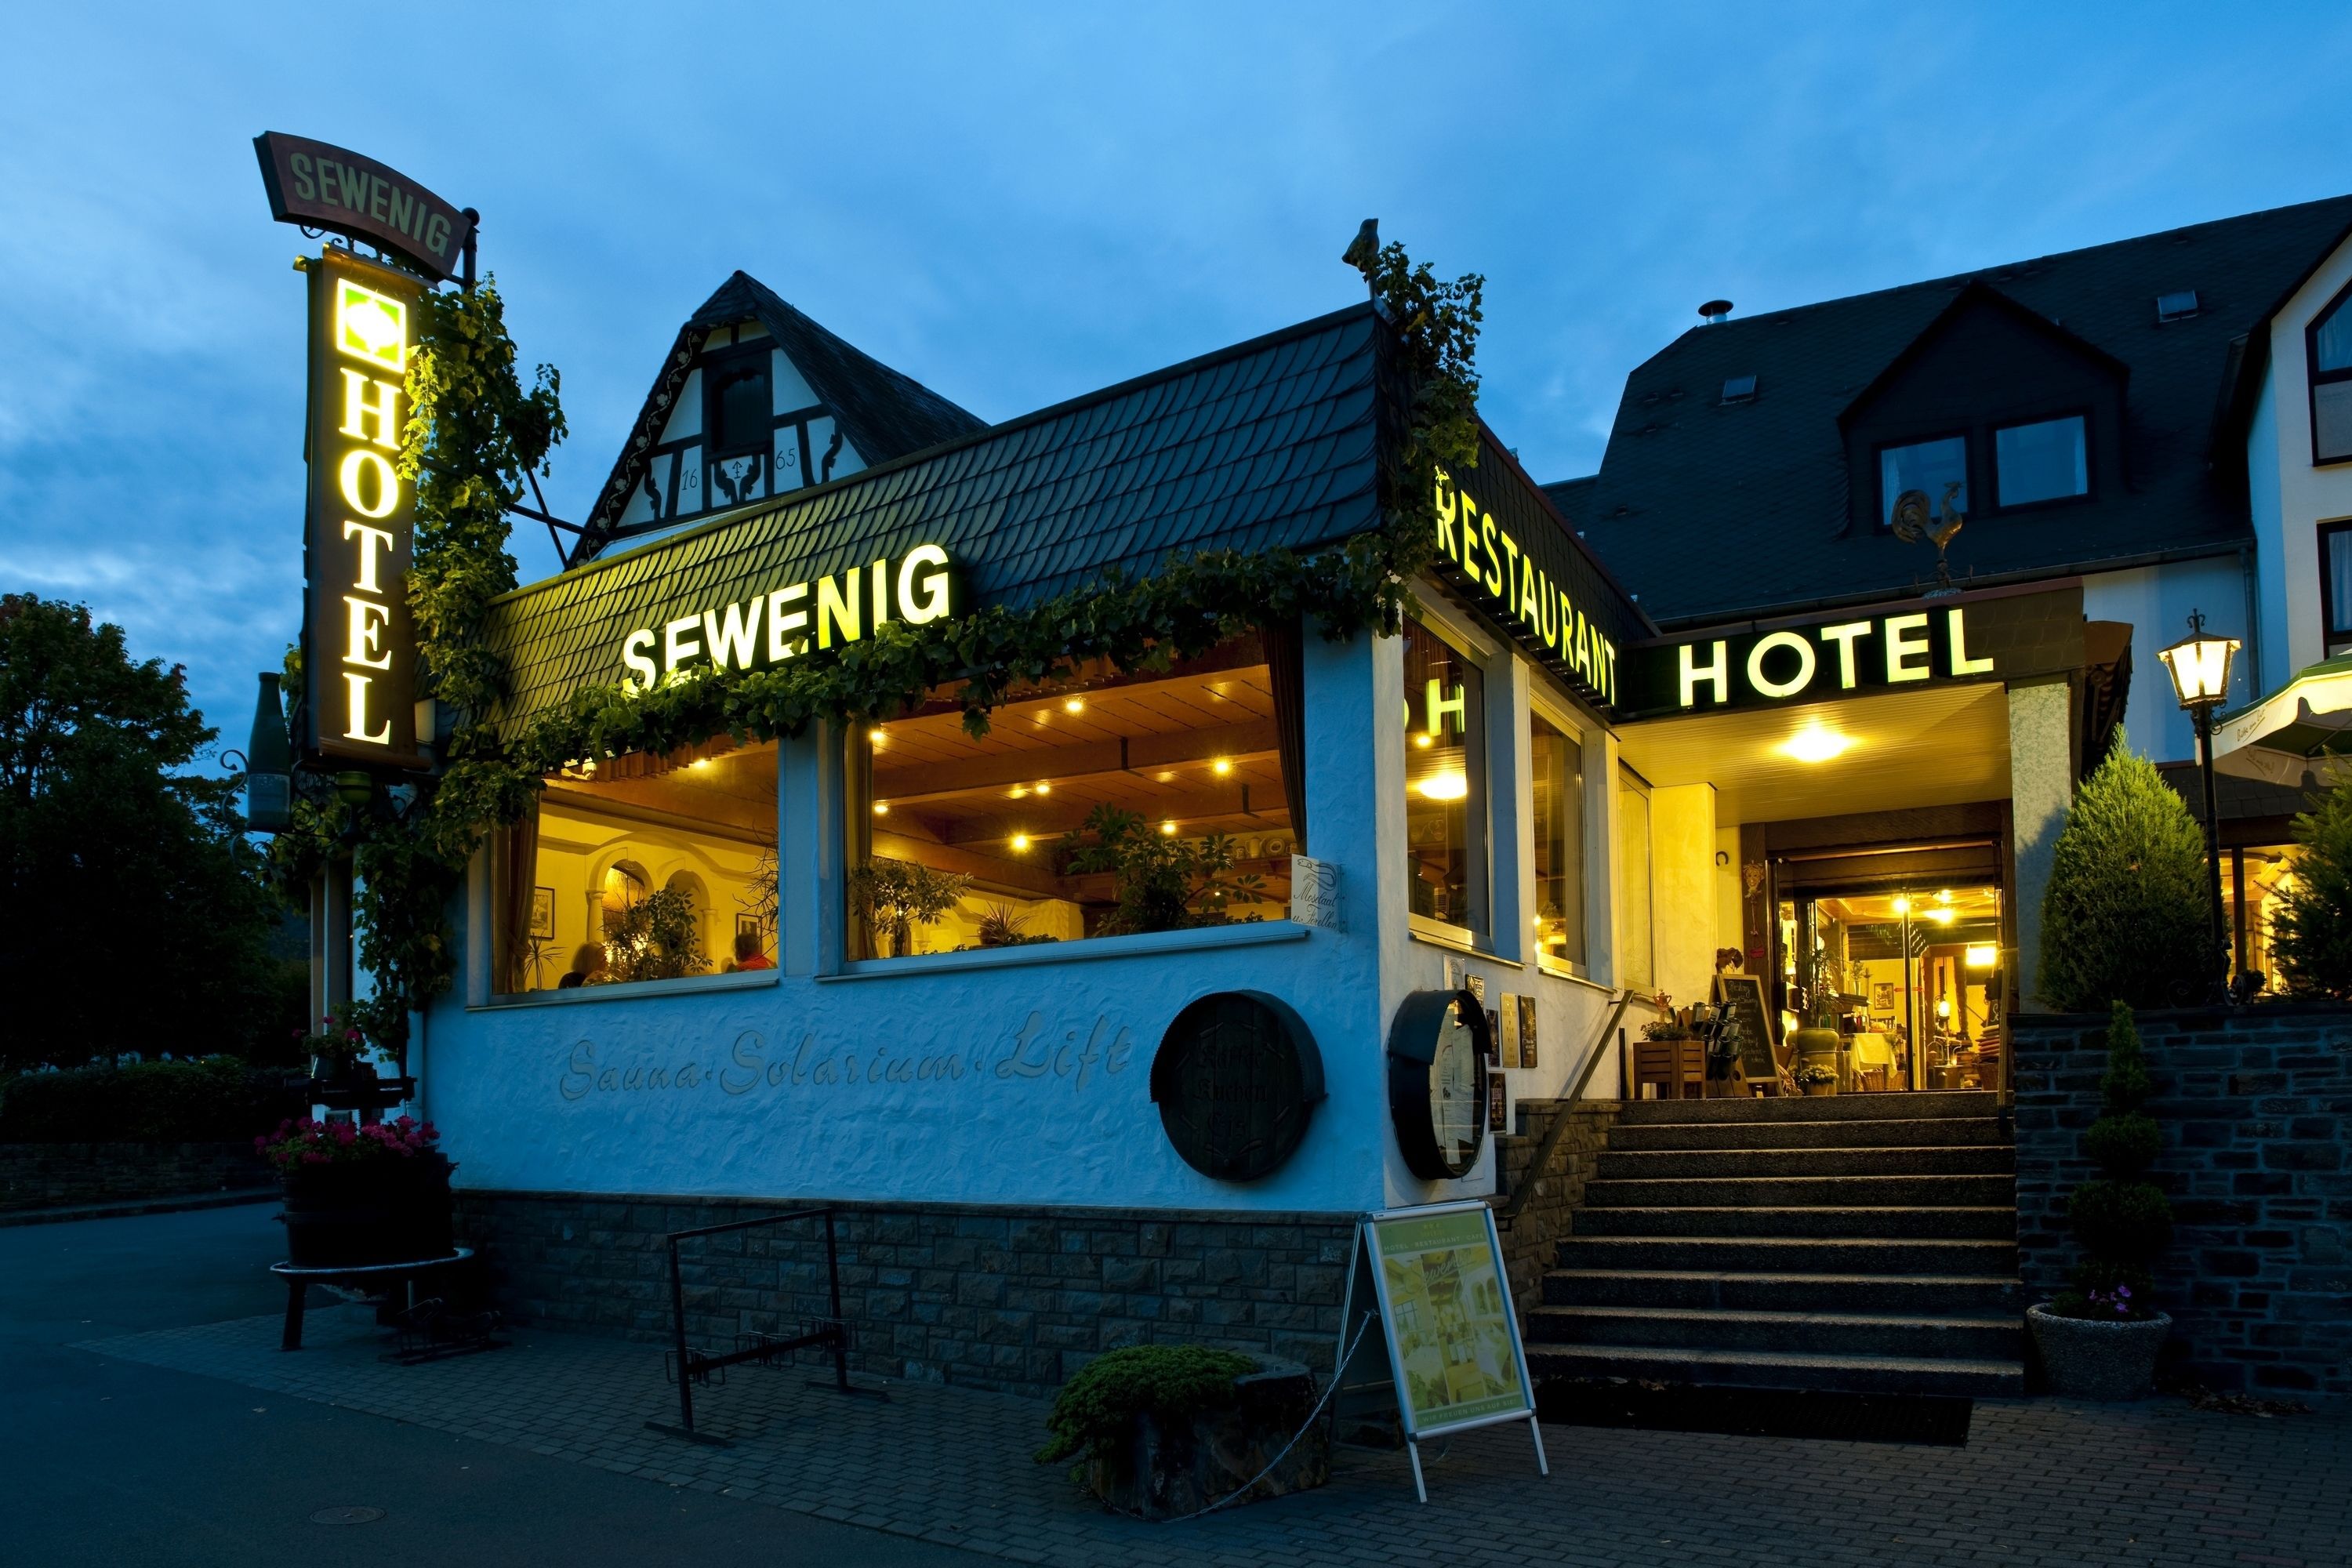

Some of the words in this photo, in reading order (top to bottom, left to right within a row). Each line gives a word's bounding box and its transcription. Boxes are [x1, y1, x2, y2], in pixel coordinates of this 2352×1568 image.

[289, 152, 452, 258] SEWENIG
[682, 468, 699, 491] 16
[775, 447, 796, 470] 65
[337, 367, 404, 746] HOTEL
[1435, 465, 1616, 707] RESTAURANT
[623, 544, 950, 698] SEWENIG
[1679, 608, 1994, 707] HOTEL
[559, 1040, 704, 1101] Sauna
[718, 1029, 964, 1095] Solarium
[994, 1010, 1132, 1097] Lift
[1384, 1243, 1409, 1252] HOTEL
[1414, 1236, 1461, 1248] RESTAURANT
[1423, 1414, 1437, 1424] WIR
[1439, 1408, 1468, 1420] FREUEN
[1470, 1405, 1486, 1414] UNS
[1486, 1401, 1500, 1410] AUF
